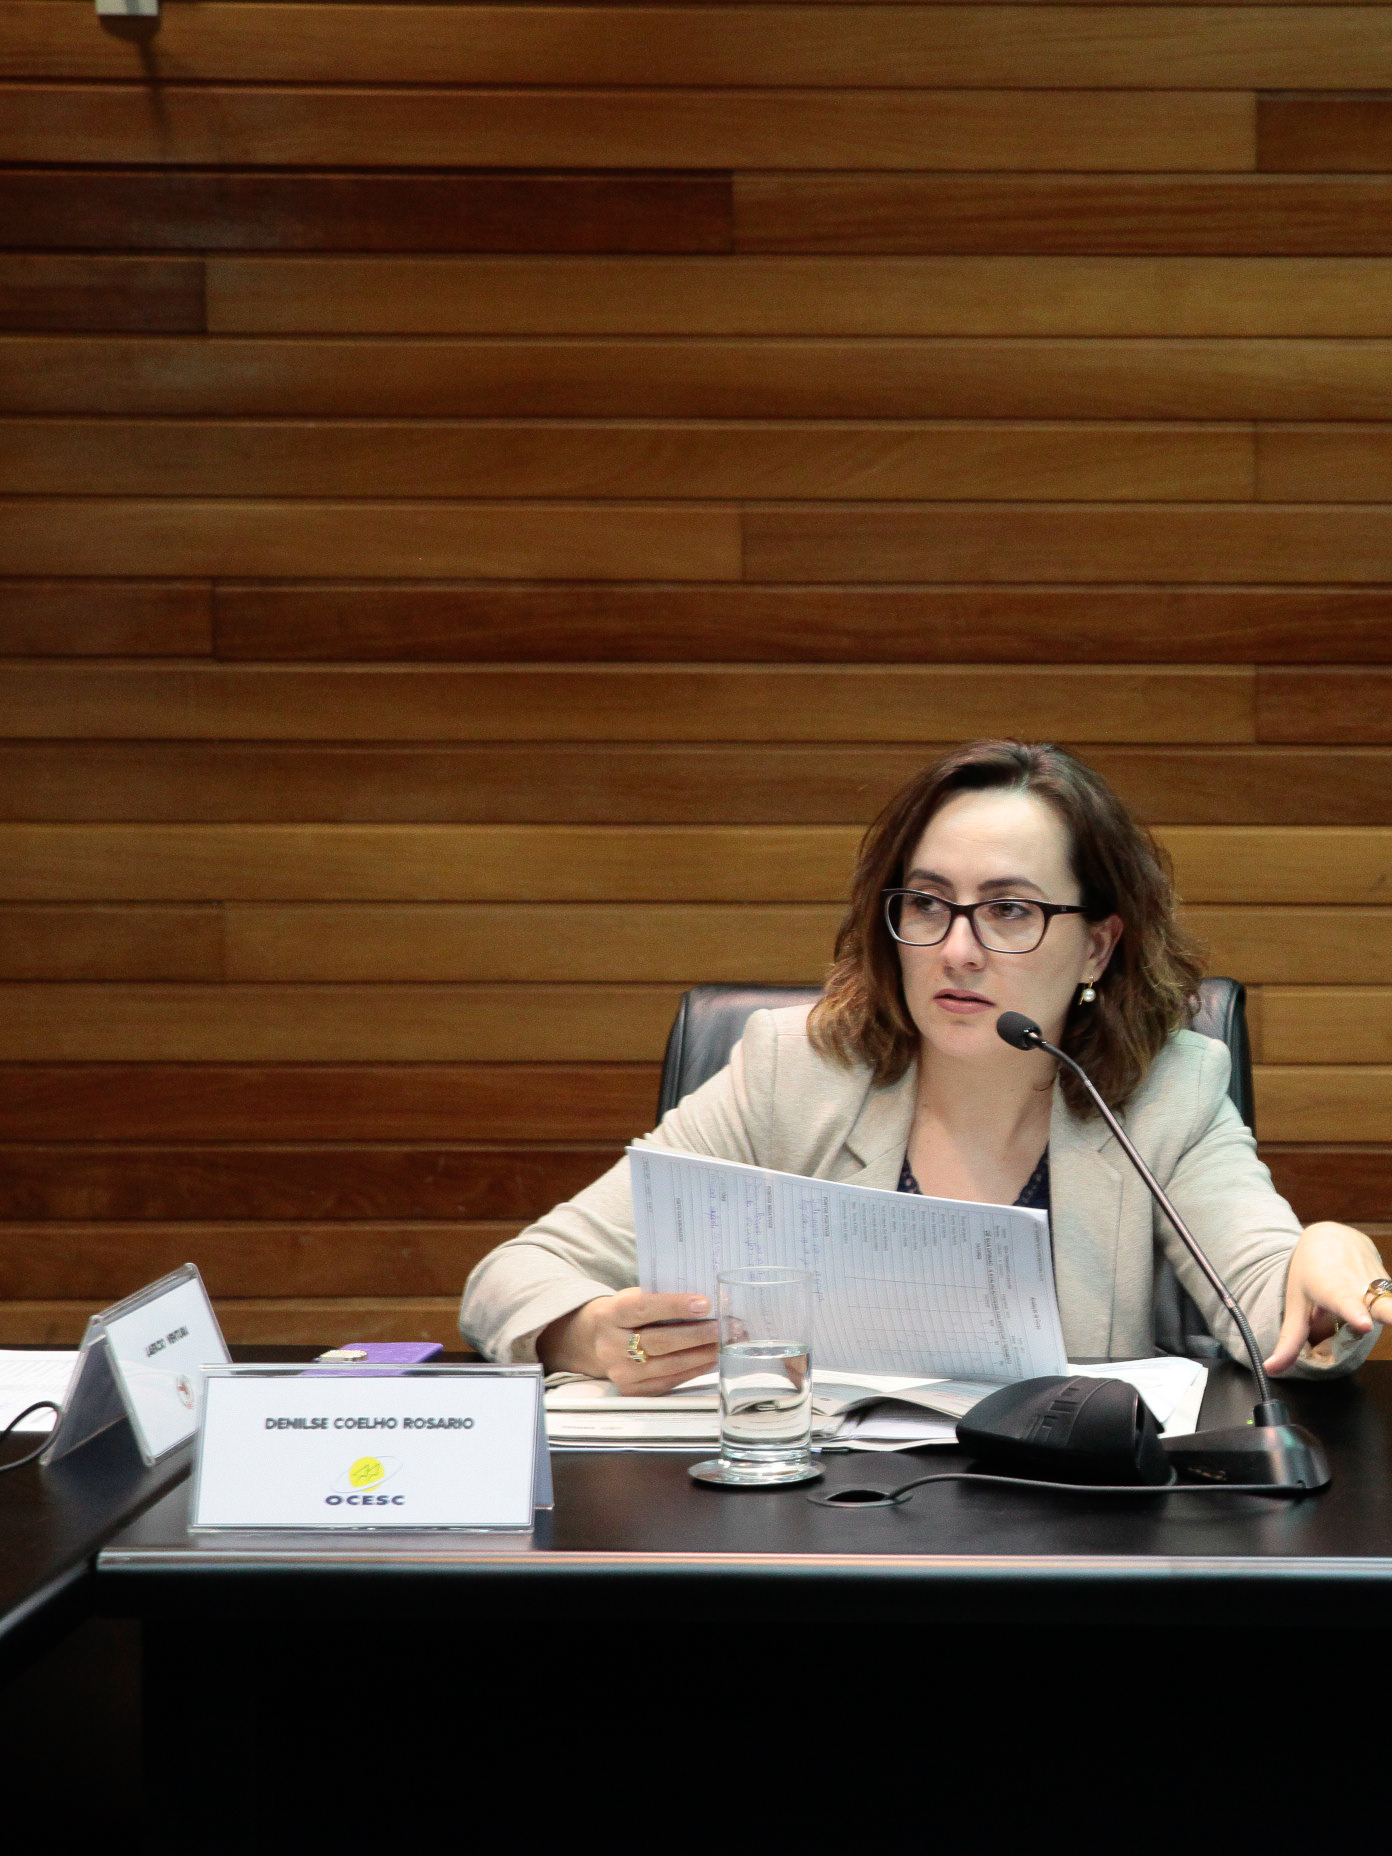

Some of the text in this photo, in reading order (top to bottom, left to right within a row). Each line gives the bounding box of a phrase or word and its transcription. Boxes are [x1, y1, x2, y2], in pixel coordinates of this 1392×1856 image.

[265, 1417, 475, 1430] DENILSE COELHO ROSARIO
[325, 1495, 406, 1506] OCESC
